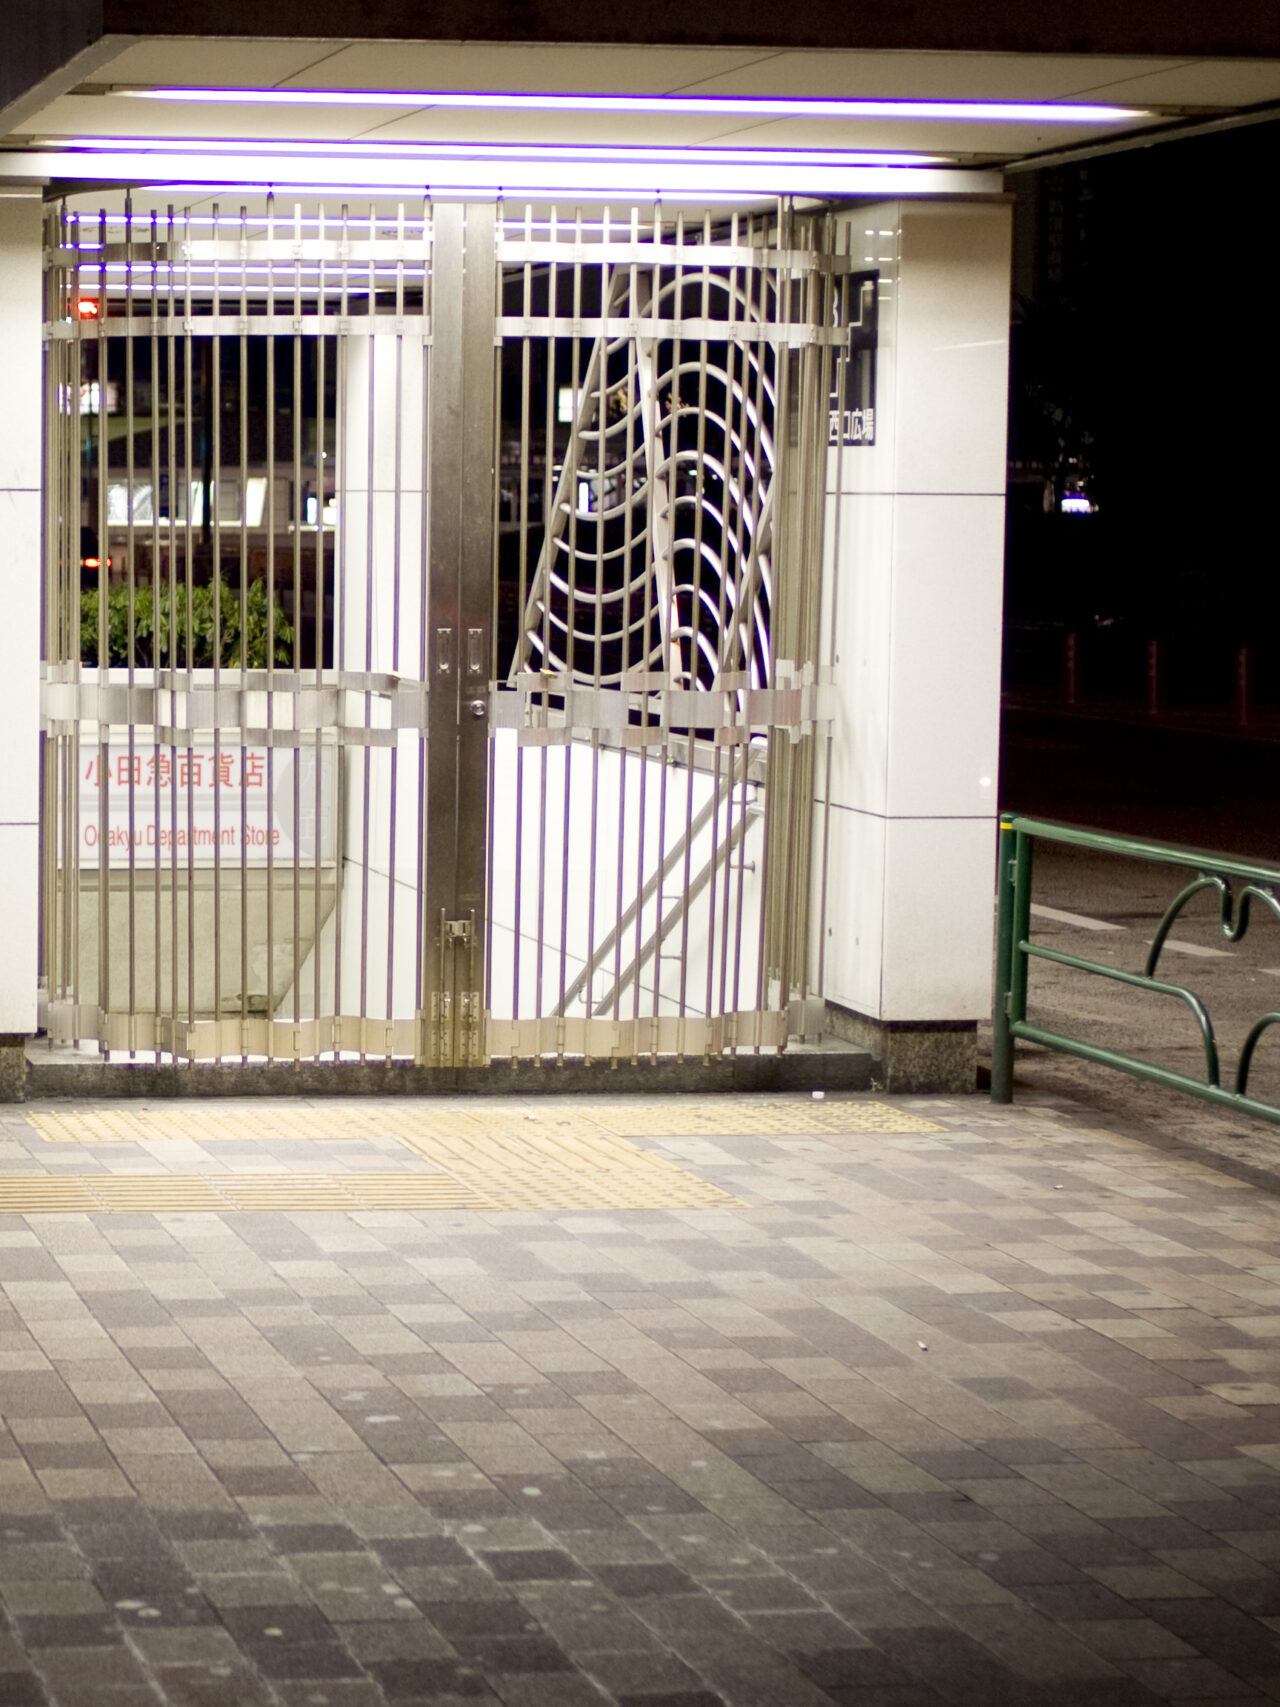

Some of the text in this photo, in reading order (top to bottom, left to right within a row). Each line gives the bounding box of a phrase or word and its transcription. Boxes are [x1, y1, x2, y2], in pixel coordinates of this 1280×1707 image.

[84, 752, 265, 788] 小田急百貨店
[84, 824, 142, 852] Oakyu
[146, 824, 235, 852] Depatmnt
